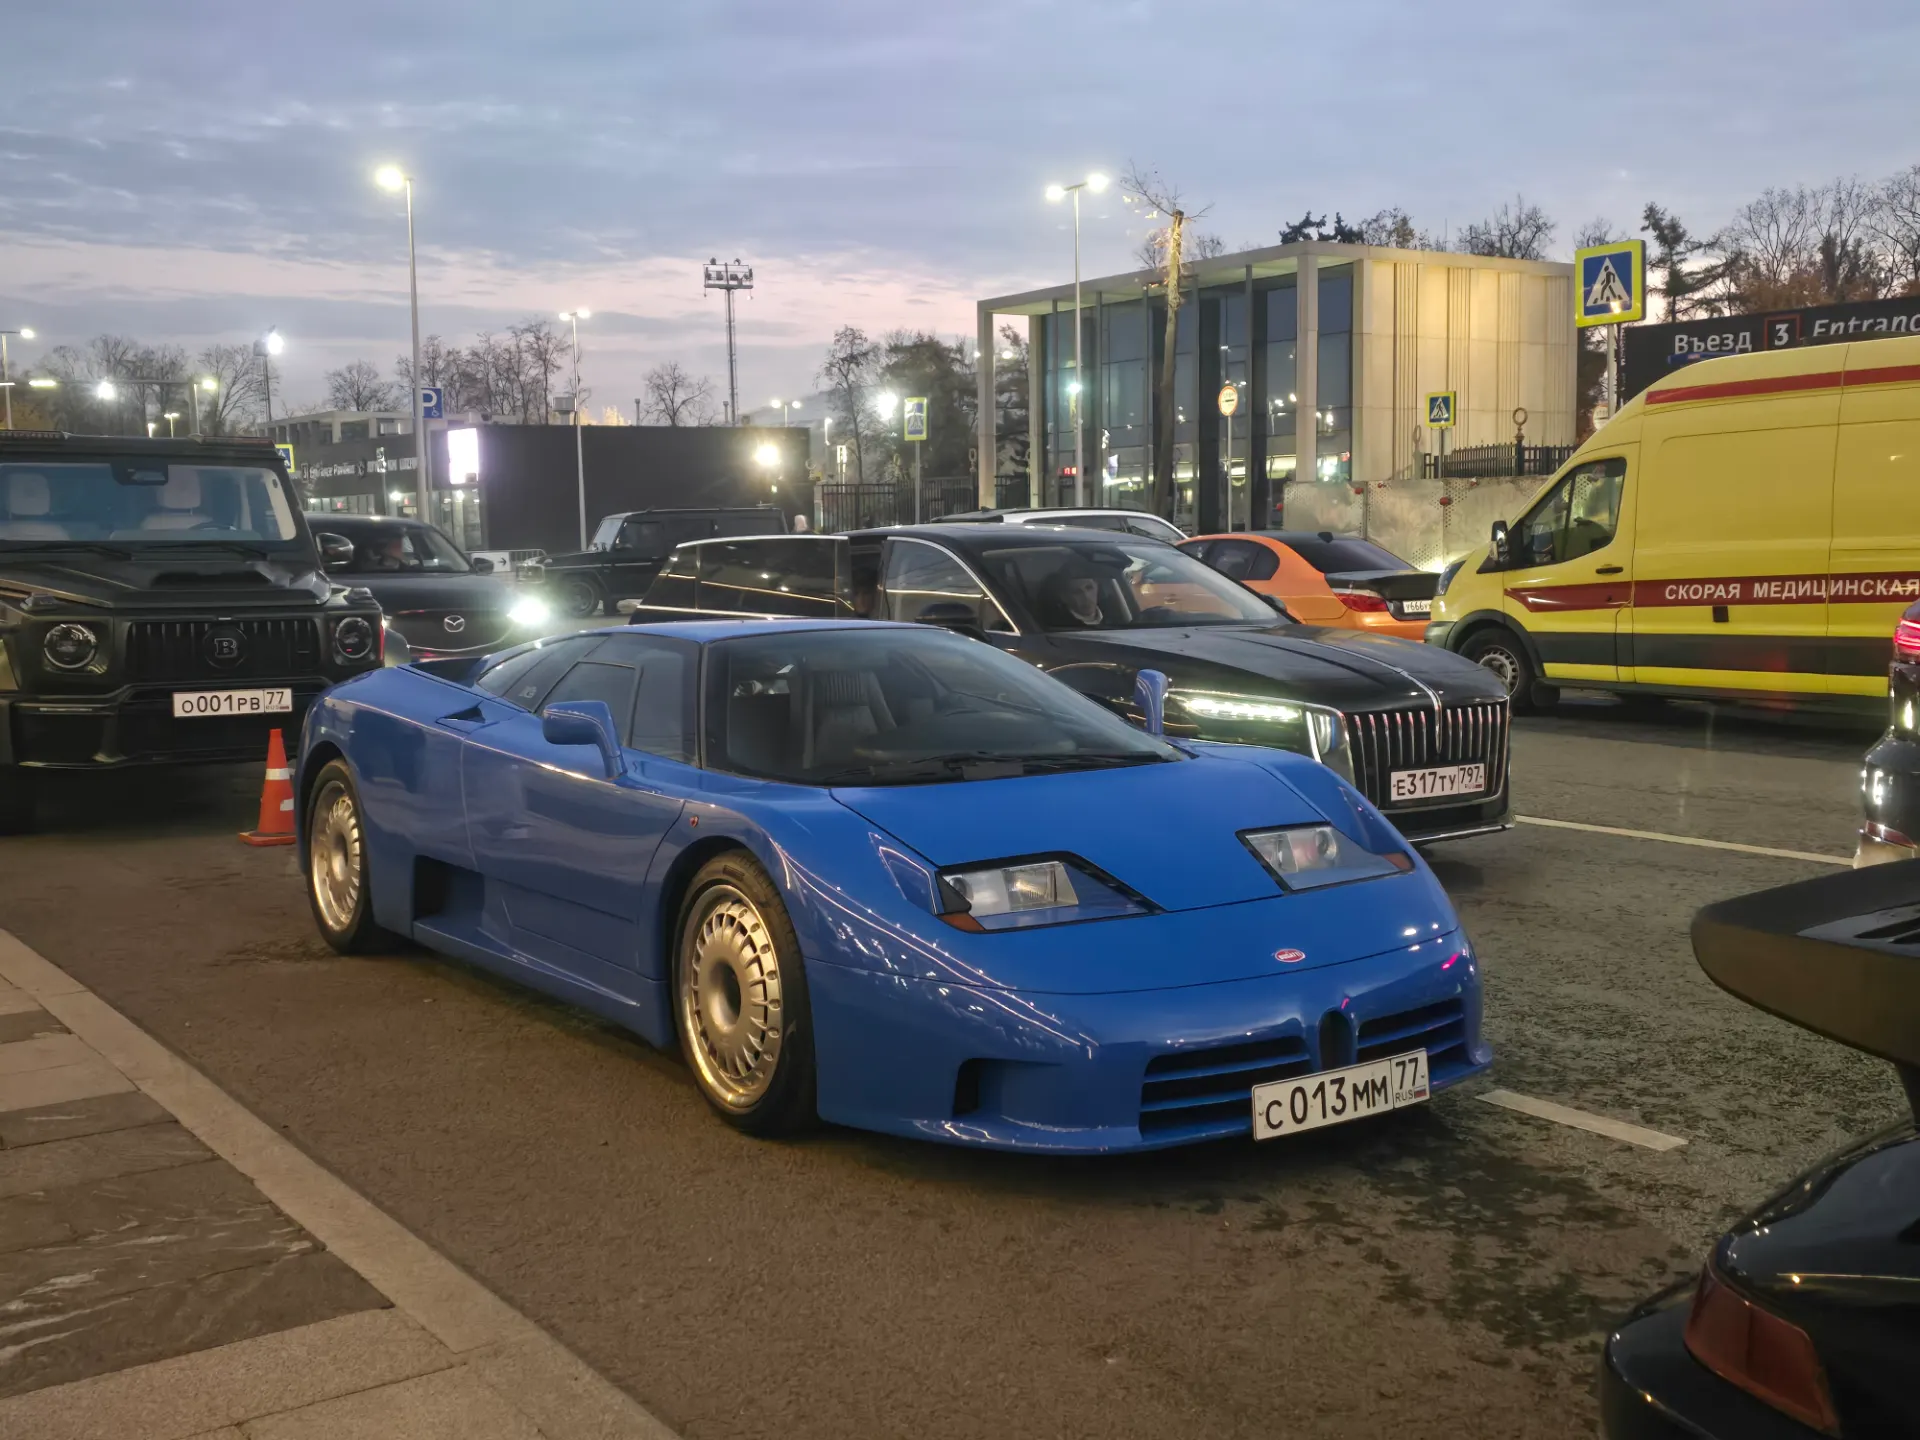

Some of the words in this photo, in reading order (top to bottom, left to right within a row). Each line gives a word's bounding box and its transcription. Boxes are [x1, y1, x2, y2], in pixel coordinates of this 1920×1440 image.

[1674, 331, 1752, 355] Въезд
[1774, 323, 1789, 346] 3
[420, 389, 437, 417] P
[1665, 584, 1741, 600] СКОРАЯ
[1753, 578, 1920, 600] МЕДИЦИНСКАЯ
[182, 694, 260, 713] О001РВ
[266, 691, 285, 705] 77
[1396, 772, 1456, 796] Е317ТУ
[1459, 766, 1480, 784] 797
[1265, 1075, 1388, 1130] С013ММ
[1395, 1057, 1419, 1090] 77
[1395, 1091, 1414, 1103] RUS
